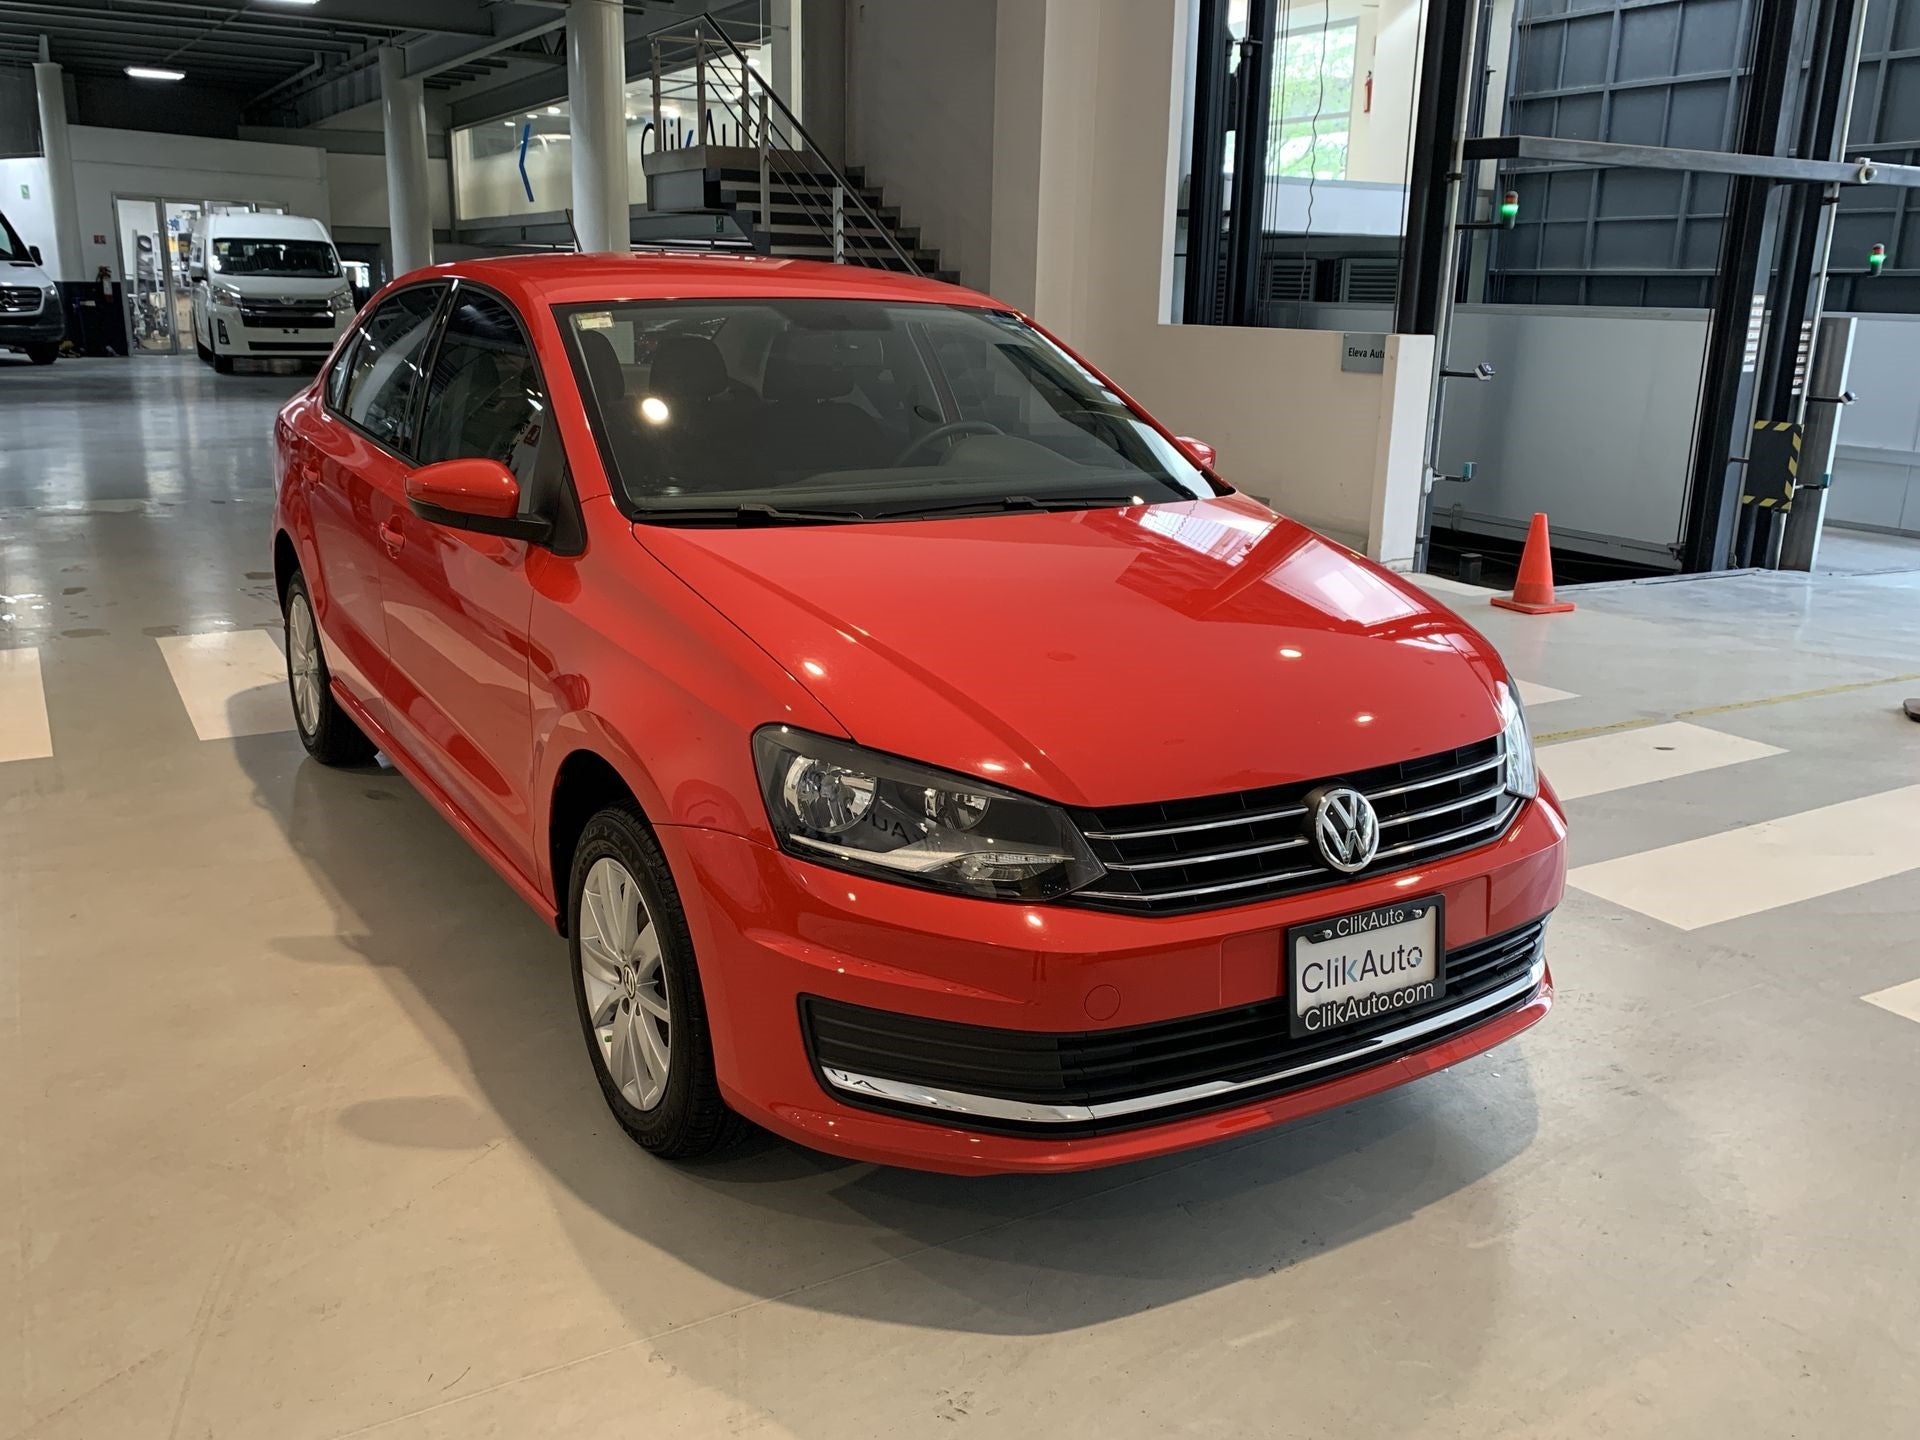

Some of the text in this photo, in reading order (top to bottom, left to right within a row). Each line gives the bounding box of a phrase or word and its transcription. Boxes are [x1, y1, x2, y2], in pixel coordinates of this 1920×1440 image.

[1348, 347, 1368, 358] Eleva
[1336, 909, 1405, 936] ClikAuto
[1302, 944, 1423, 993] ClikAuto
[1305, 982, 1434, 1031] ClikAuto.com
